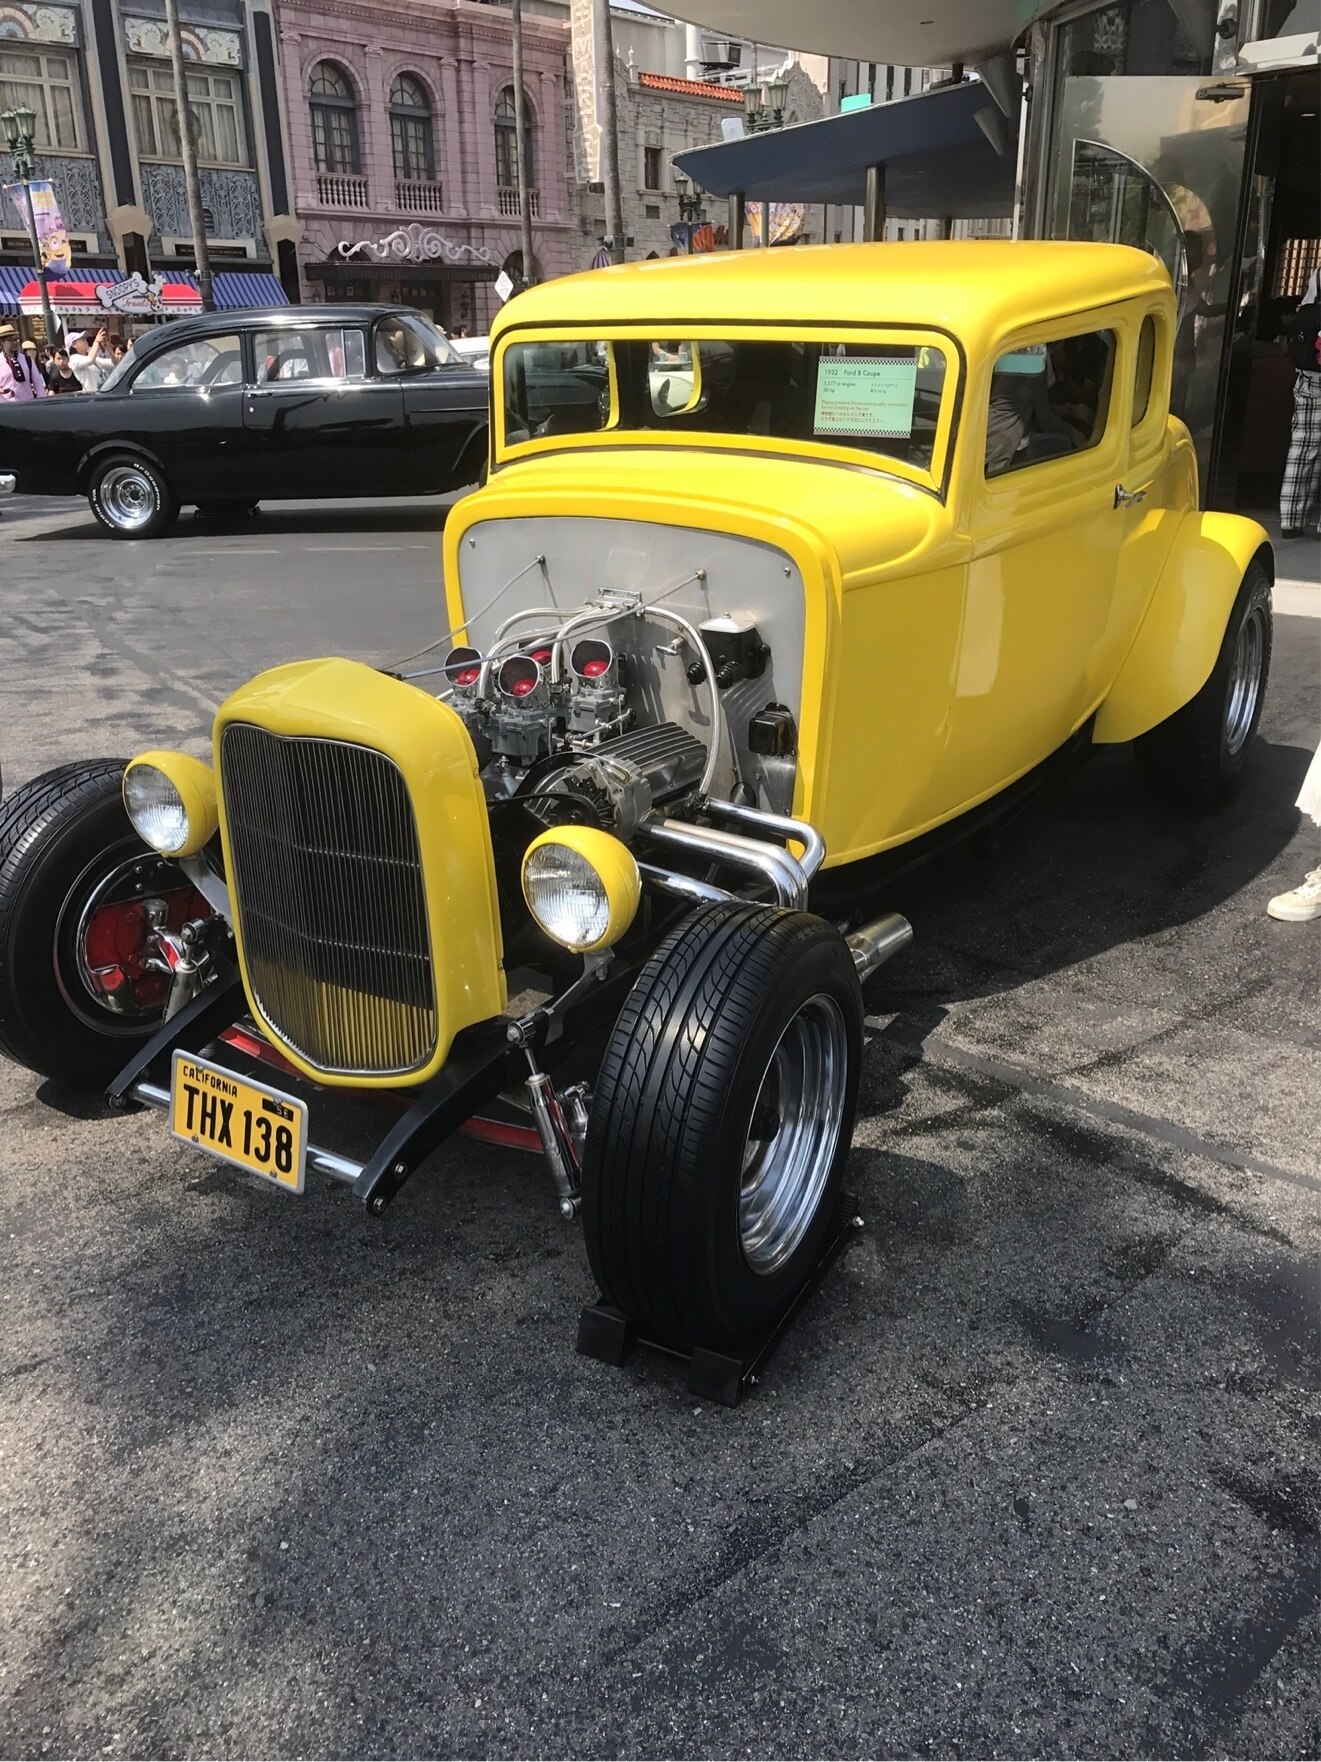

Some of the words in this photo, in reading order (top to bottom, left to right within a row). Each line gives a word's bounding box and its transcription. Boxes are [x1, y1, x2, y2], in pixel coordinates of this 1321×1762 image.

[106, 279, 140, 299] SNOOPY'S
[122, 297, 149, 308] Treats
[863, 370, 881, 378] Coupe
[183, 1065, 238, 1098] CALIFORNIA
[183, 1083, 234, 1148] THX
[243, 1109, 293, 1174] 138
